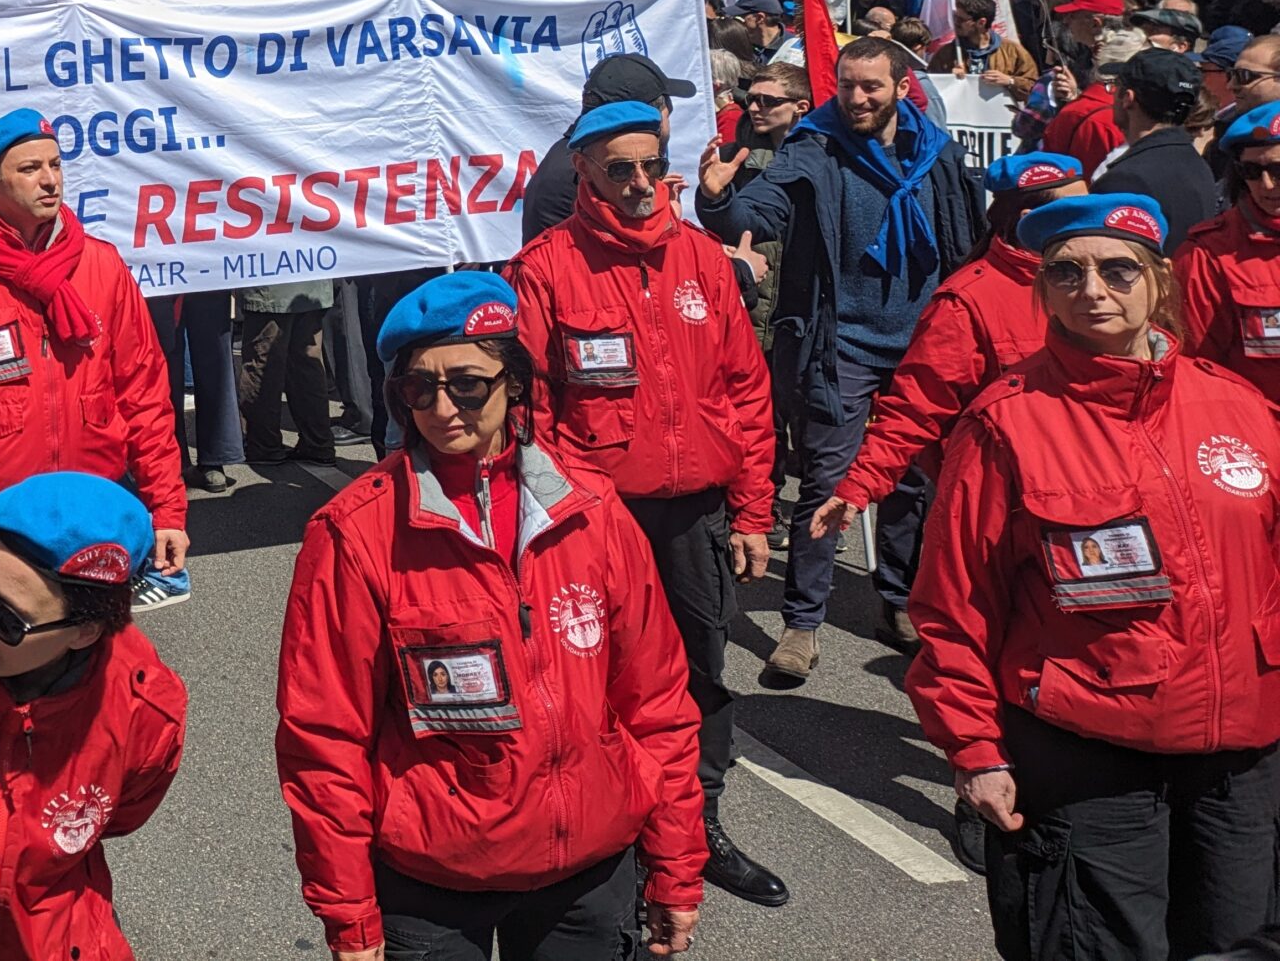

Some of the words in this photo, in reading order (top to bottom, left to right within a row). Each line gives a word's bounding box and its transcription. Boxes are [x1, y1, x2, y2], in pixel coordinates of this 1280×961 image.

[44, 35, 238, 88] GHETTO
[256, 29, 310, 75] DI
[326, 14, 562, 68] VARSAVIA
[51, 106, 226, 161] OGGI...
[951, 129, 1012, 167] PRILE
[1019, 169, 1033, 186] CITY
[1033, 165, 1066, 179] ANGELS
[133, 149, 539, 249] RESISTENZA
[1108, 208, 1130, 225] CITY
[1132, 208, 1161, 240] ANGELS
[223, 245, 338, 281] MILANO
[467, 308, 485, 332] CITY
[1197, 441, 1213, 476] CITY
[1211, 434, 1268, 469] ANGELS
[77, 549, 100, 563] CITY
[79, 566, 117, 581] LUGANO
[549, 593, 562, 633] CITY
[561, 583, 606, 618] ANGELS
[41, 790, 70, 829] CITY
[75, 783, 113, 825] ANGELS
